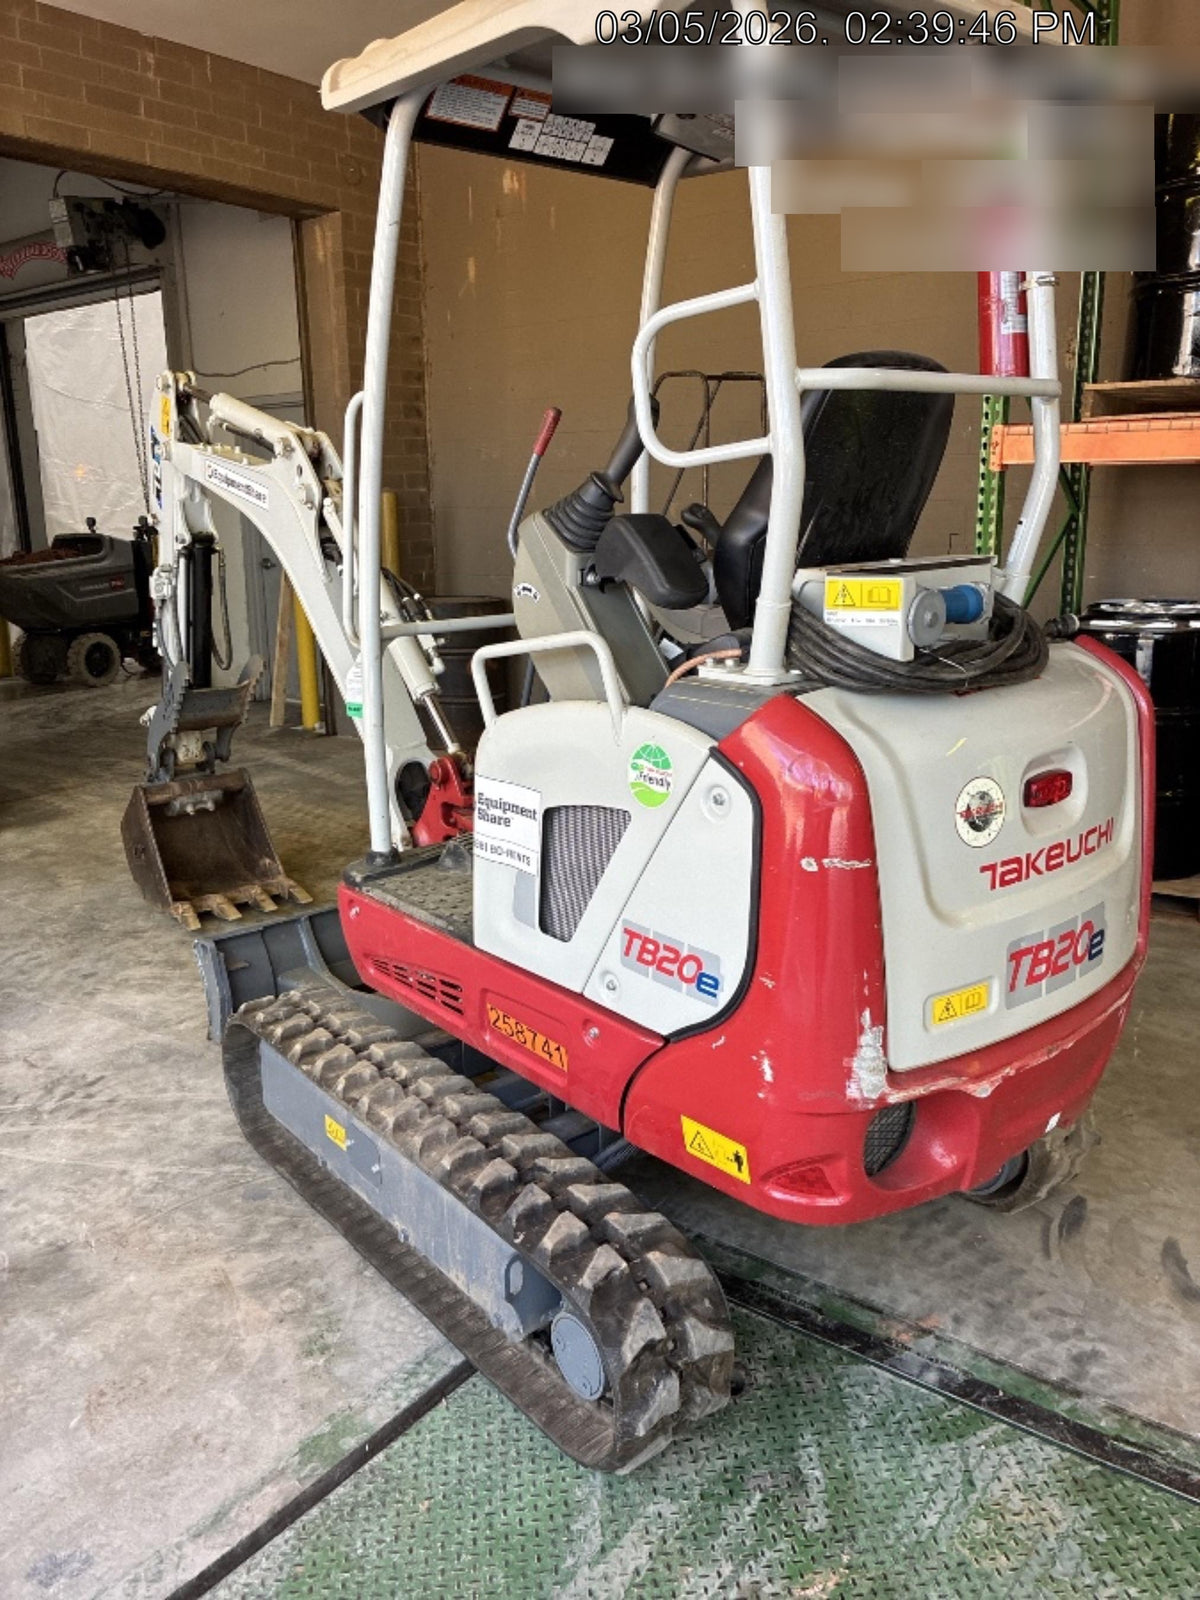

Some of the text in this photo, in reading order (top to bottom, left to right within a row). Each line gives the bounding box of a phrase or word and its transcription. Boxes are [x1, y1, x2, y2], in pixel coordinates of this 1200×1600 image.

[477, 792, 537, 821] Equipment
[477, 807, 511, 827] Share
[623, 926, 720, 999] TB20e
[1008, 920, 1105, 993] TB20e
[489, 1006, 565, 1068] 258741
